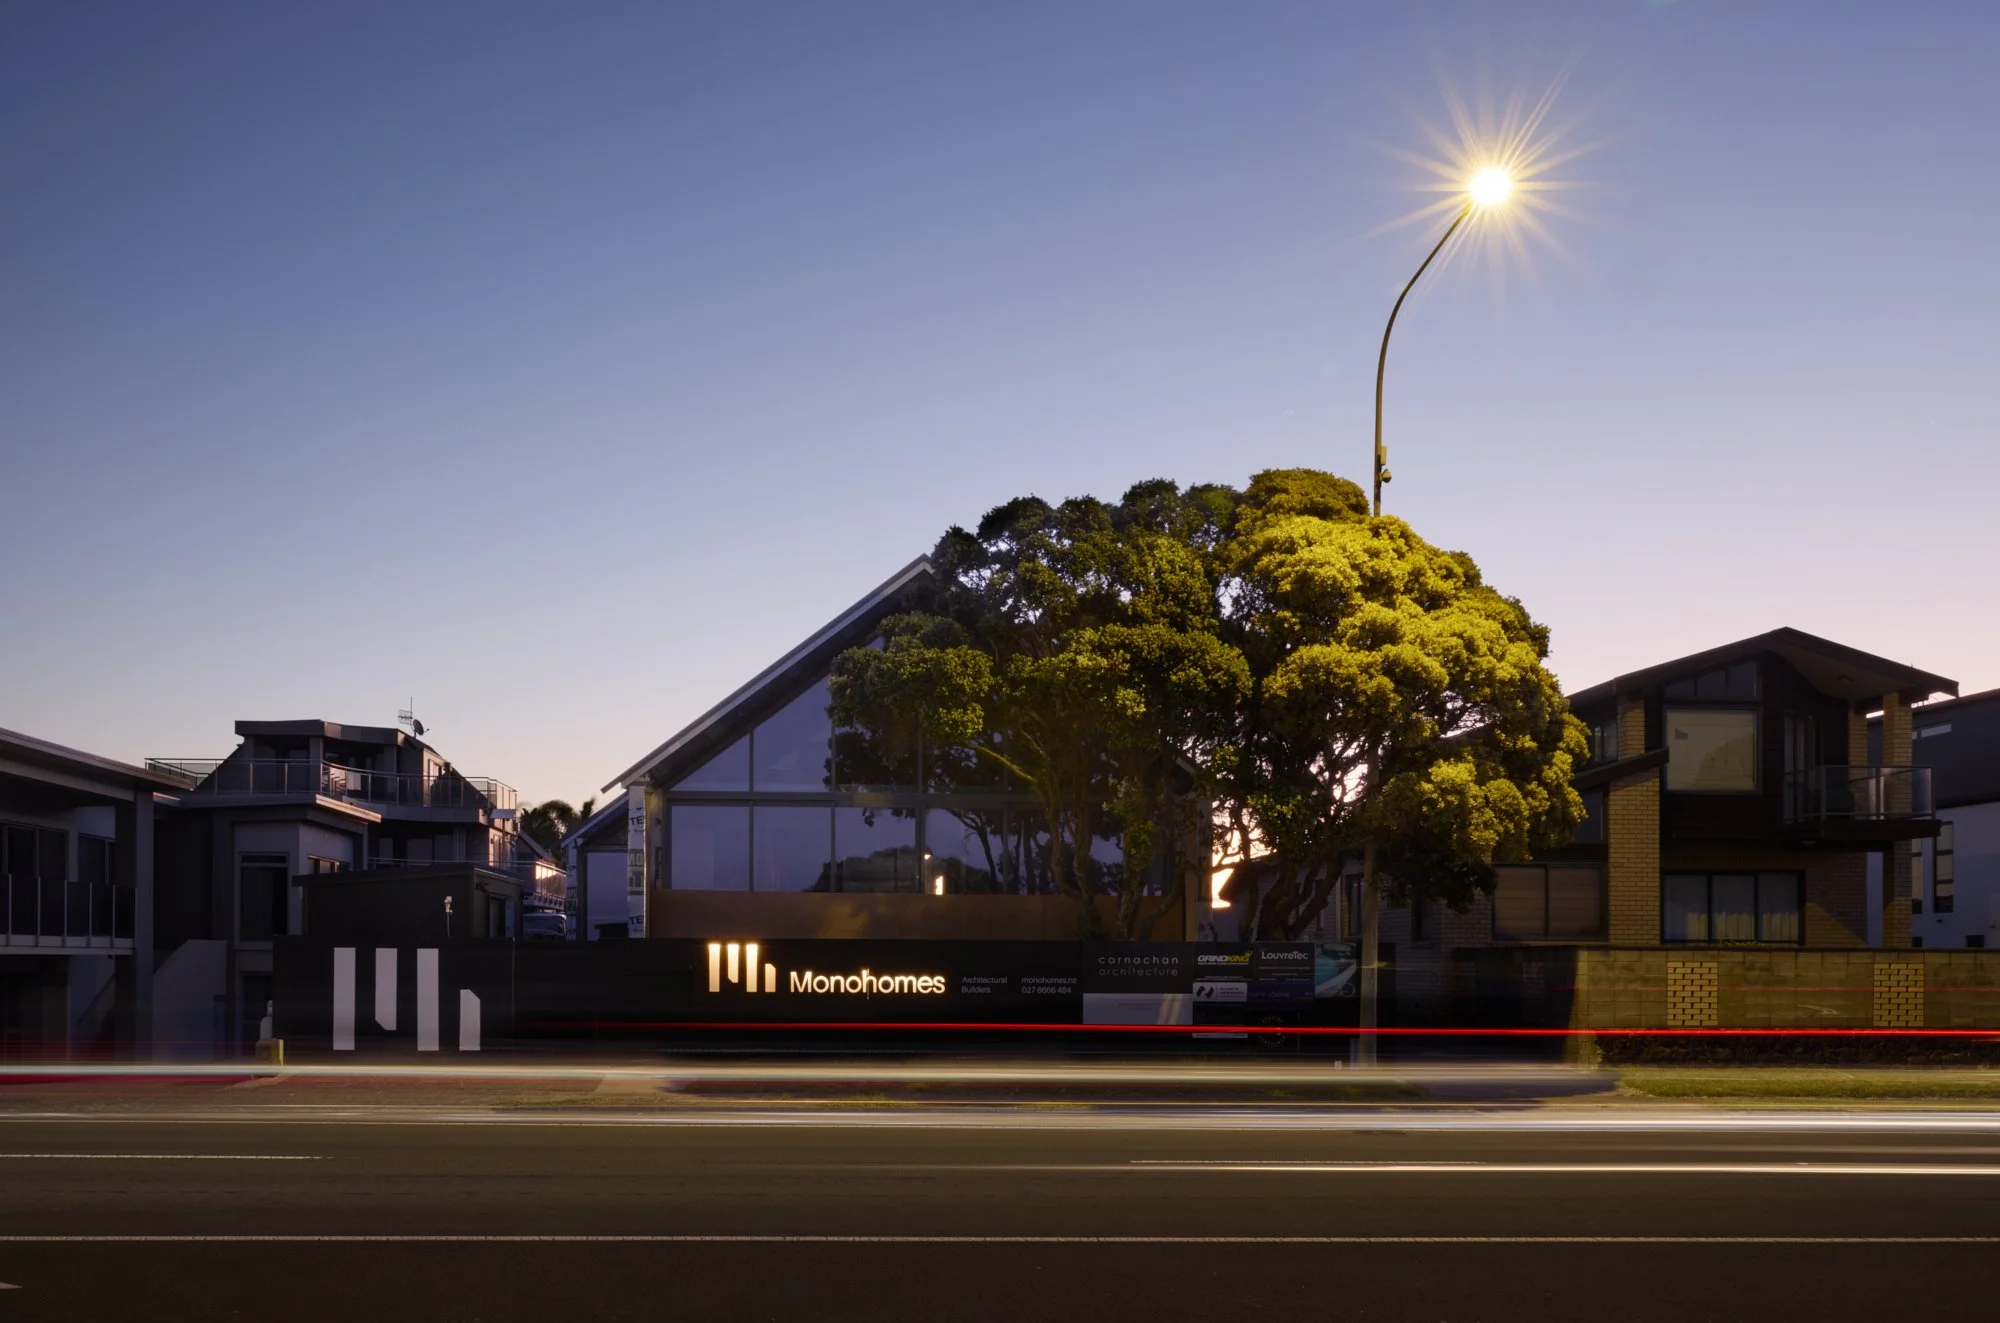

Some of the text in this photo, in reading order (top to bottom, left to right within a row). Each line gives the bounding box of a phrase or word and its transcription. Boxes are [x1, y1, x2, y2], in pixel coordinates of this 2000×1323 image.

[1098, 955, 1179, 965] carnachan
[1261, 951, 1309, 960] LouvreTec
[1098, 967, 1179, 976] architecture
[790, 969, 946, 994] Monohomes
[962, 976, 1008, 984] Architectural
[1021, 976, 1077, 984] monohomes.nz
